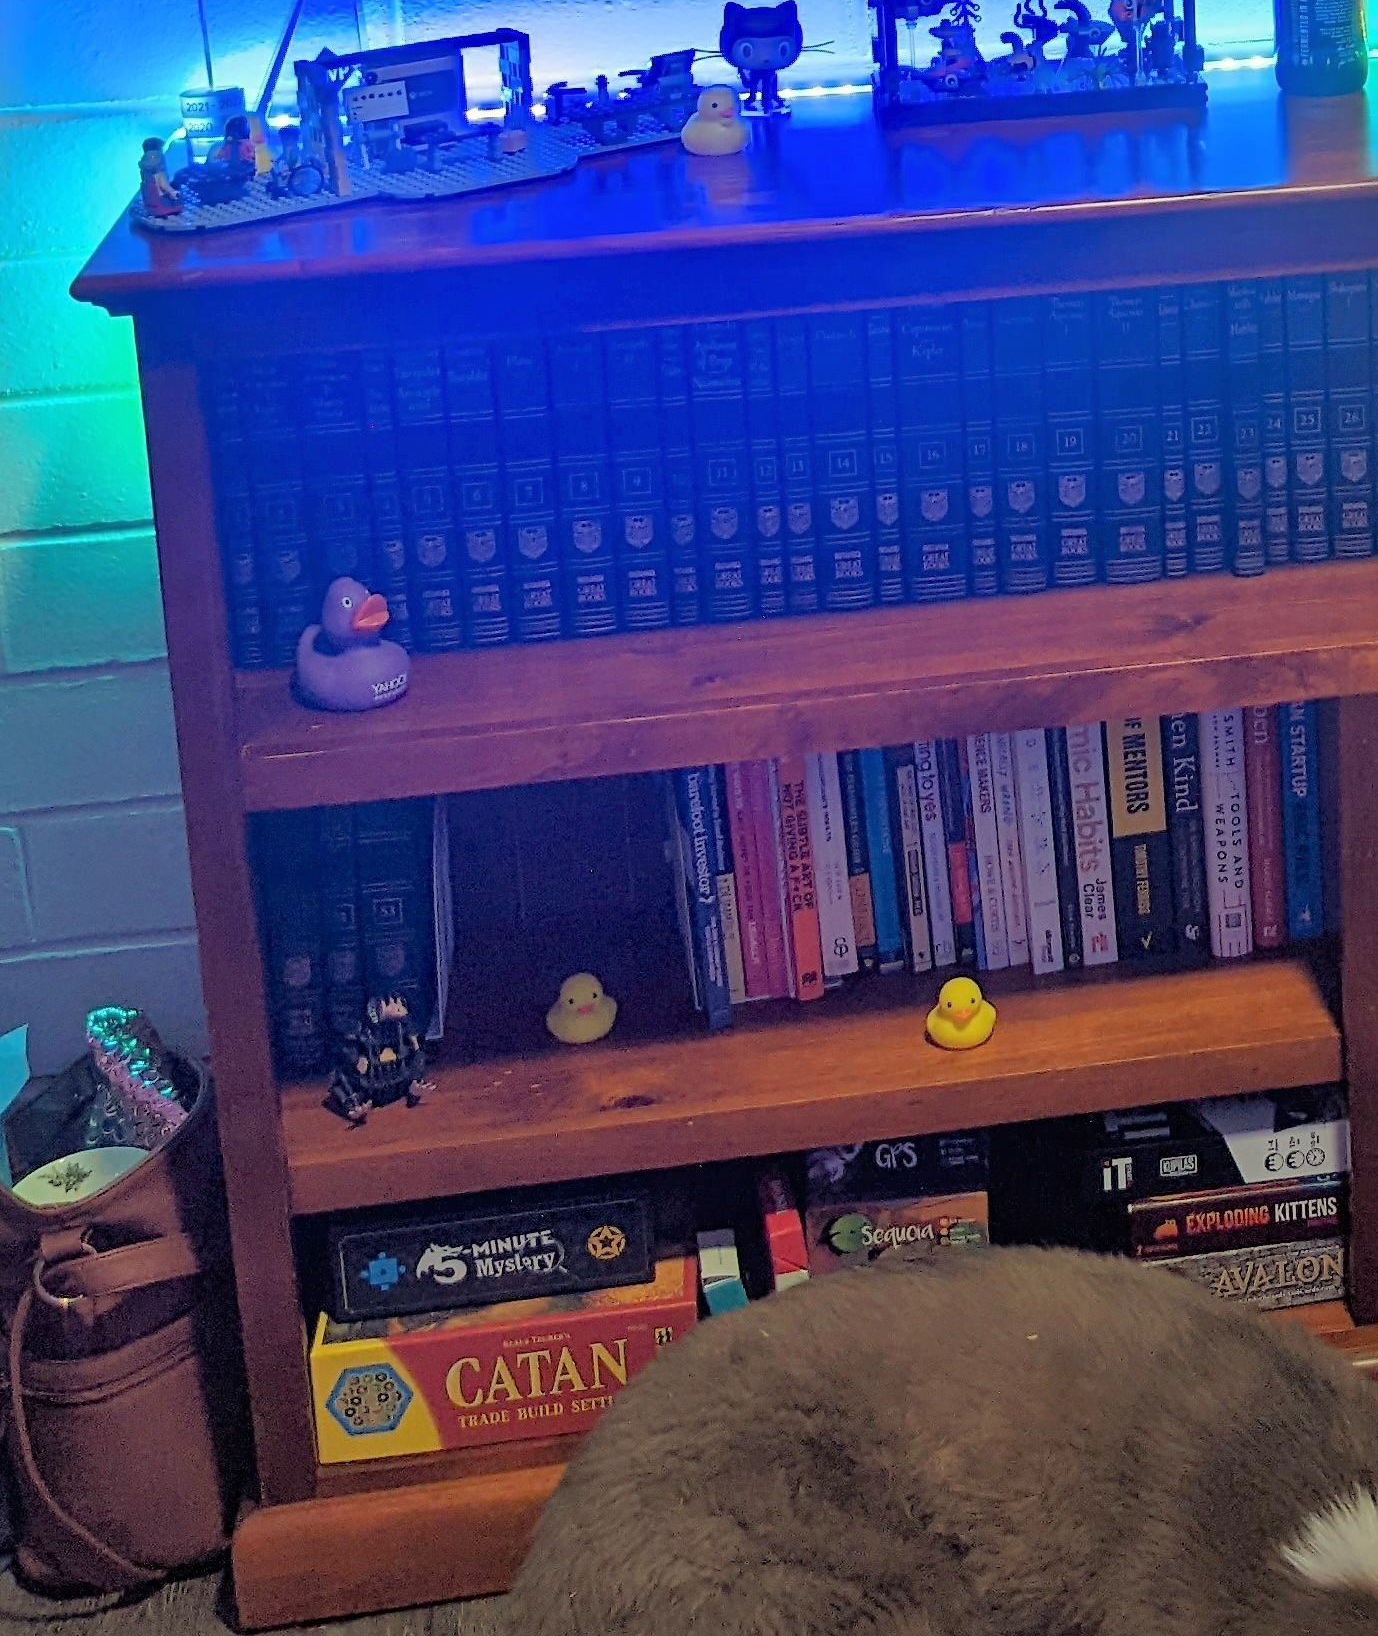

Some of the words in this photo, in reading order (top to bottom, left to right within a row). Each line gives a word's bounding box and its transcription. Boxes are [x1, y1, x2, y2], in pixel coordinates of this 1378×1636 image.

[1223, 714, 1236, 767] SMITH
[1289, 725, 1308, 799] STARTUP
[1122, 733, 1150, 814] MENTORS
[1172, 754, 1199, 814] Kind
[920, 794, 938, 822] yes
[1075, 780, 1103, 873] Habits
[1229, 792, 1243, 847] TOOLS
[1214, 803, 1229, 884] WEAPONS
[1233, 854, 1244, 889] AND
[1083, 882, 1095, 919] Clear
[1094, 878, 1108, 921] James
[875, 1141, 918, 1170] GPS
[861, 1224, 935, 1250] Sequoia
[1185, 1204, 1271, 1235] EXPLODING
[1273, 1196, 1338, 1222] KITTENS
[475, 1250, 556, 1279] Mystery
[1214, 1247, 1345, 1299] AVALON
[446, 1338, 630, 1409] CATAN
[458, 1410, 511, 1428] TRADE
[517, 1402, 564, 1420] BUILD
